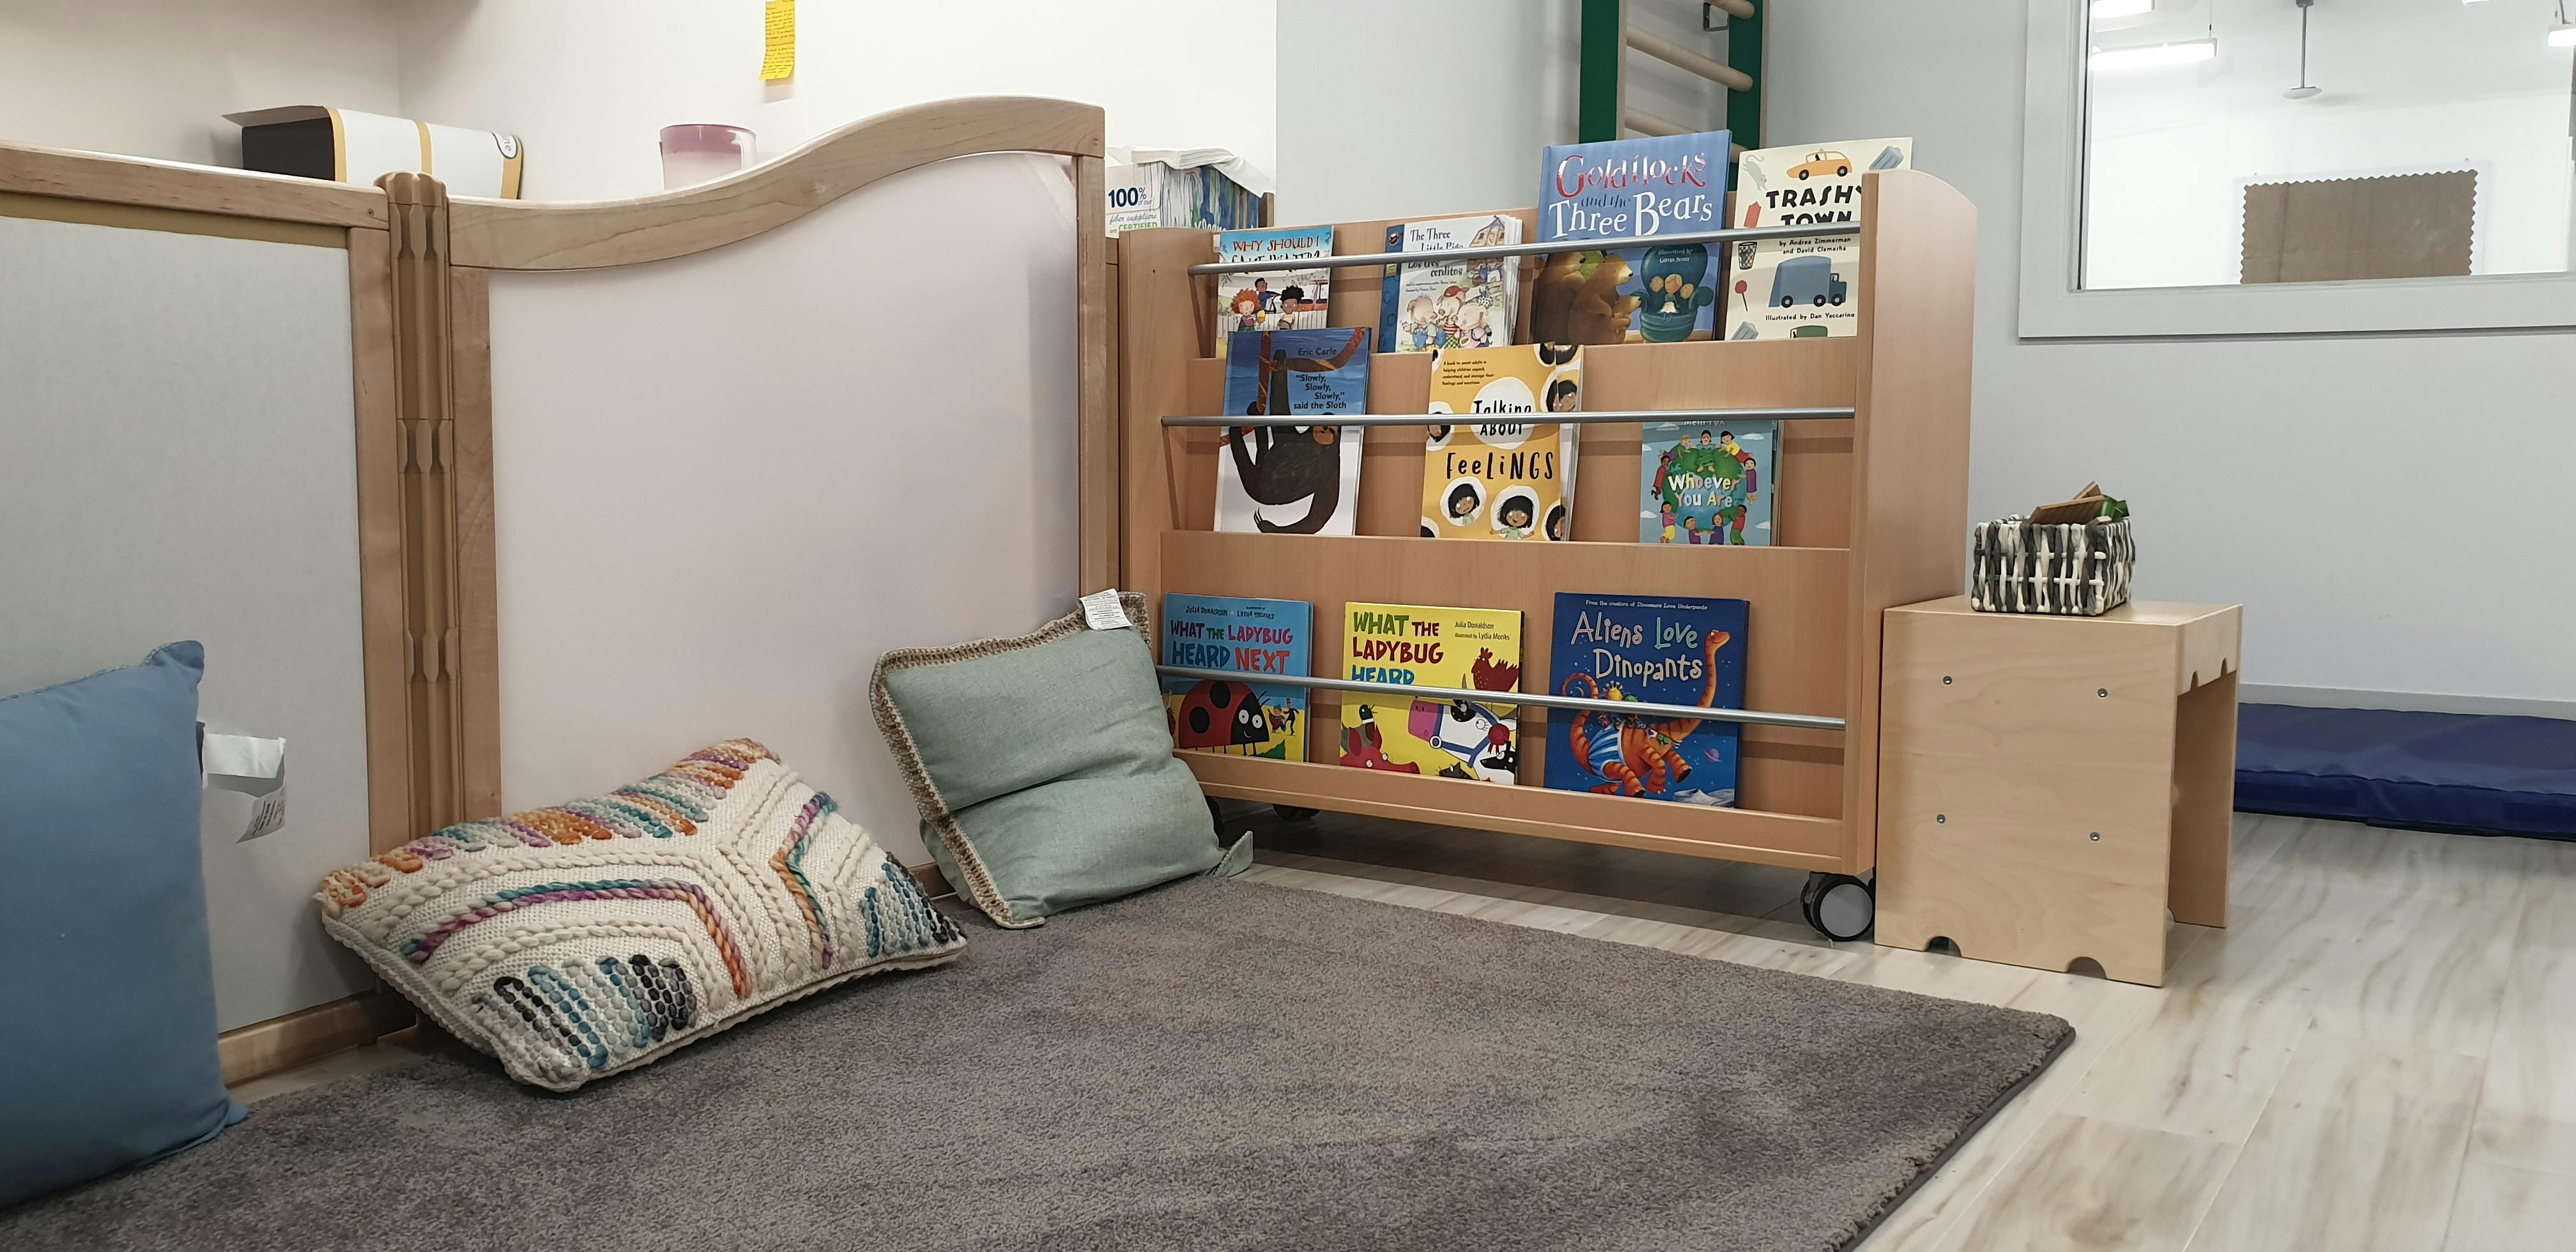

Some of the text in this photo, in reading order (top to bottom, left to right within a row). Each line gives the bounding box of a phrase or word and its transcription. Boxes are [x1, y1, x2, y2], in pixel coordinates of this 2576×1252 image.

[1556, 153, 1706, 198] Goldilocks
[1108, 187, 1147, 208] 100%
[1766, 185, 1862, 209] TRASH
[1549, 191, 1712, 239] Three Bears
[1232, 240, 1263, 252] WHY
[1267, 236, 1314, 251] SHOULD
[1410, 229, 1425, 242] The
[1427, 227, 1451, 240] Three
[1298, 347, 1337, 356] Eric Carle
[1305, 383, 1331, 392] Slowly,
[1480, 424, 1522, 436] ABOUT
[1668, 473, 1740, 491] Whoever
[1675, 491, 1733, 507] You Are
[1170, 620, 1294, 645] WHAT THE LADYBUG
[1353, 611, 1439, 637] WHAT THE
[1655, 616, 1698, 649] Love
[1172, 641, 1291, 675] HEARD NEXT
[1353, 636, 1444, 664] LADYBUG
[1351, 664, 1414, 685] HEARD
[1593, 648, 1703, 687] Dinopants
